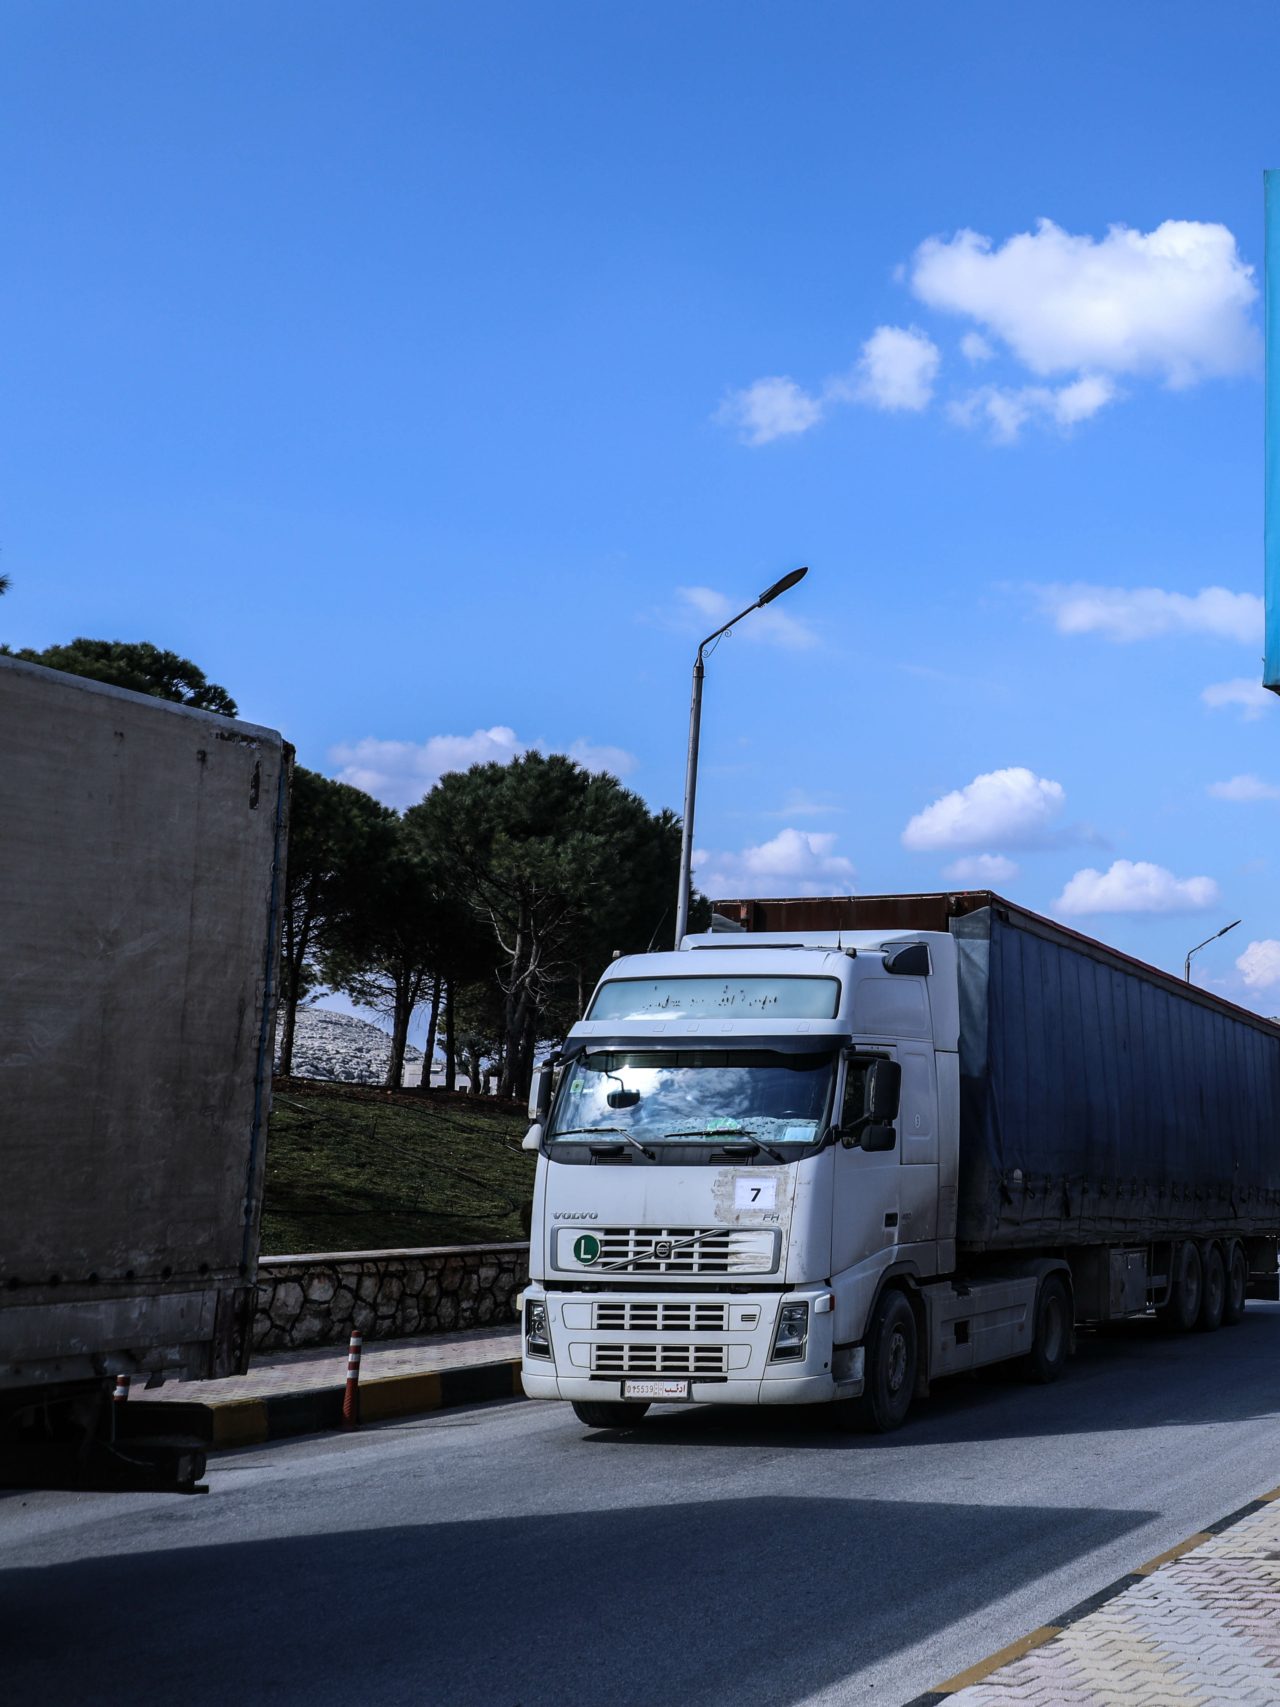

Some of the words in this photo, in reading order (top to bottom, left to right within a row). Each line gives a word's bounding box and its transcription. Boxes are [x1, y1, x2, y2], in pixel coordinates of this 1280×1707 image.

[750, 1187, 762, 1203] 7
[553, 1211, 599, 1220] VOLVO
[763, 1213, 780, 1222] FH
[580, 1239, 592, 1259] L
